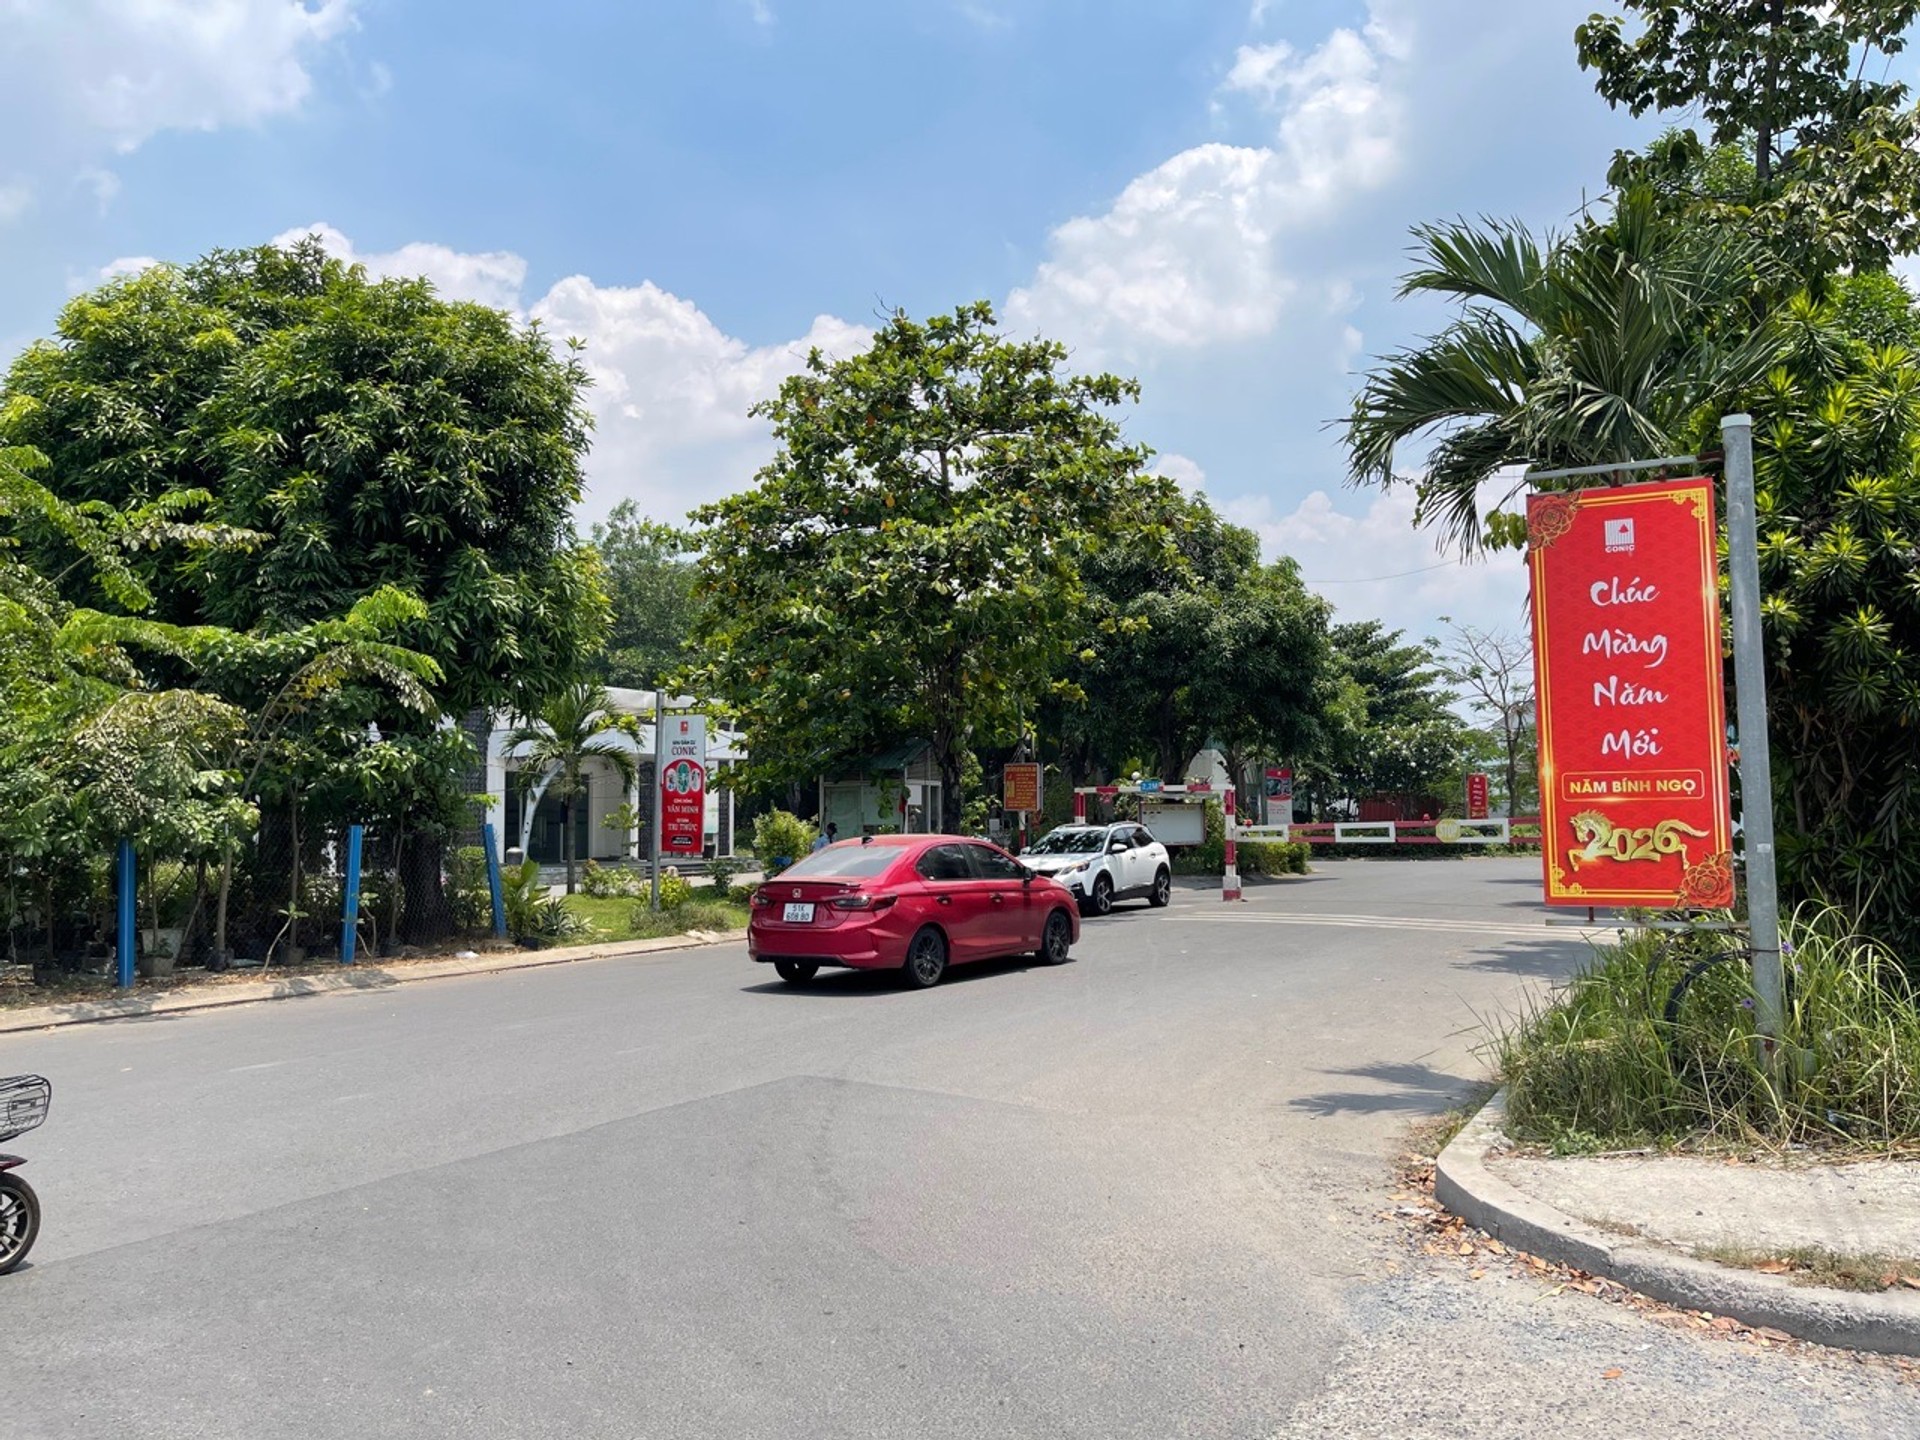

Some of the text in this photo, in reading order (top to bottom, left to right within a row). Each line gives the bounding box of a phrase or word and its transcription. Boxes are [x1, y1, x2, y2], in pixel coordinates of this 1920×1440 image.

[1604, 544, 1635, 554] CONIC
[1589, 576, 1660, 606] Chúc
[1582, 628, 1668, 669] Mừng
[1592, 674, 1669, 708] Năm
[671, 746, 697, 756] CONIC
[1601, 727, 1664, 758] Mới
[1569, 776, 1697, 796] NĂM BÍNH NGỌ
[1585, 820, 1682, 863] 2026
[792, 904, 805, 912] 51K
